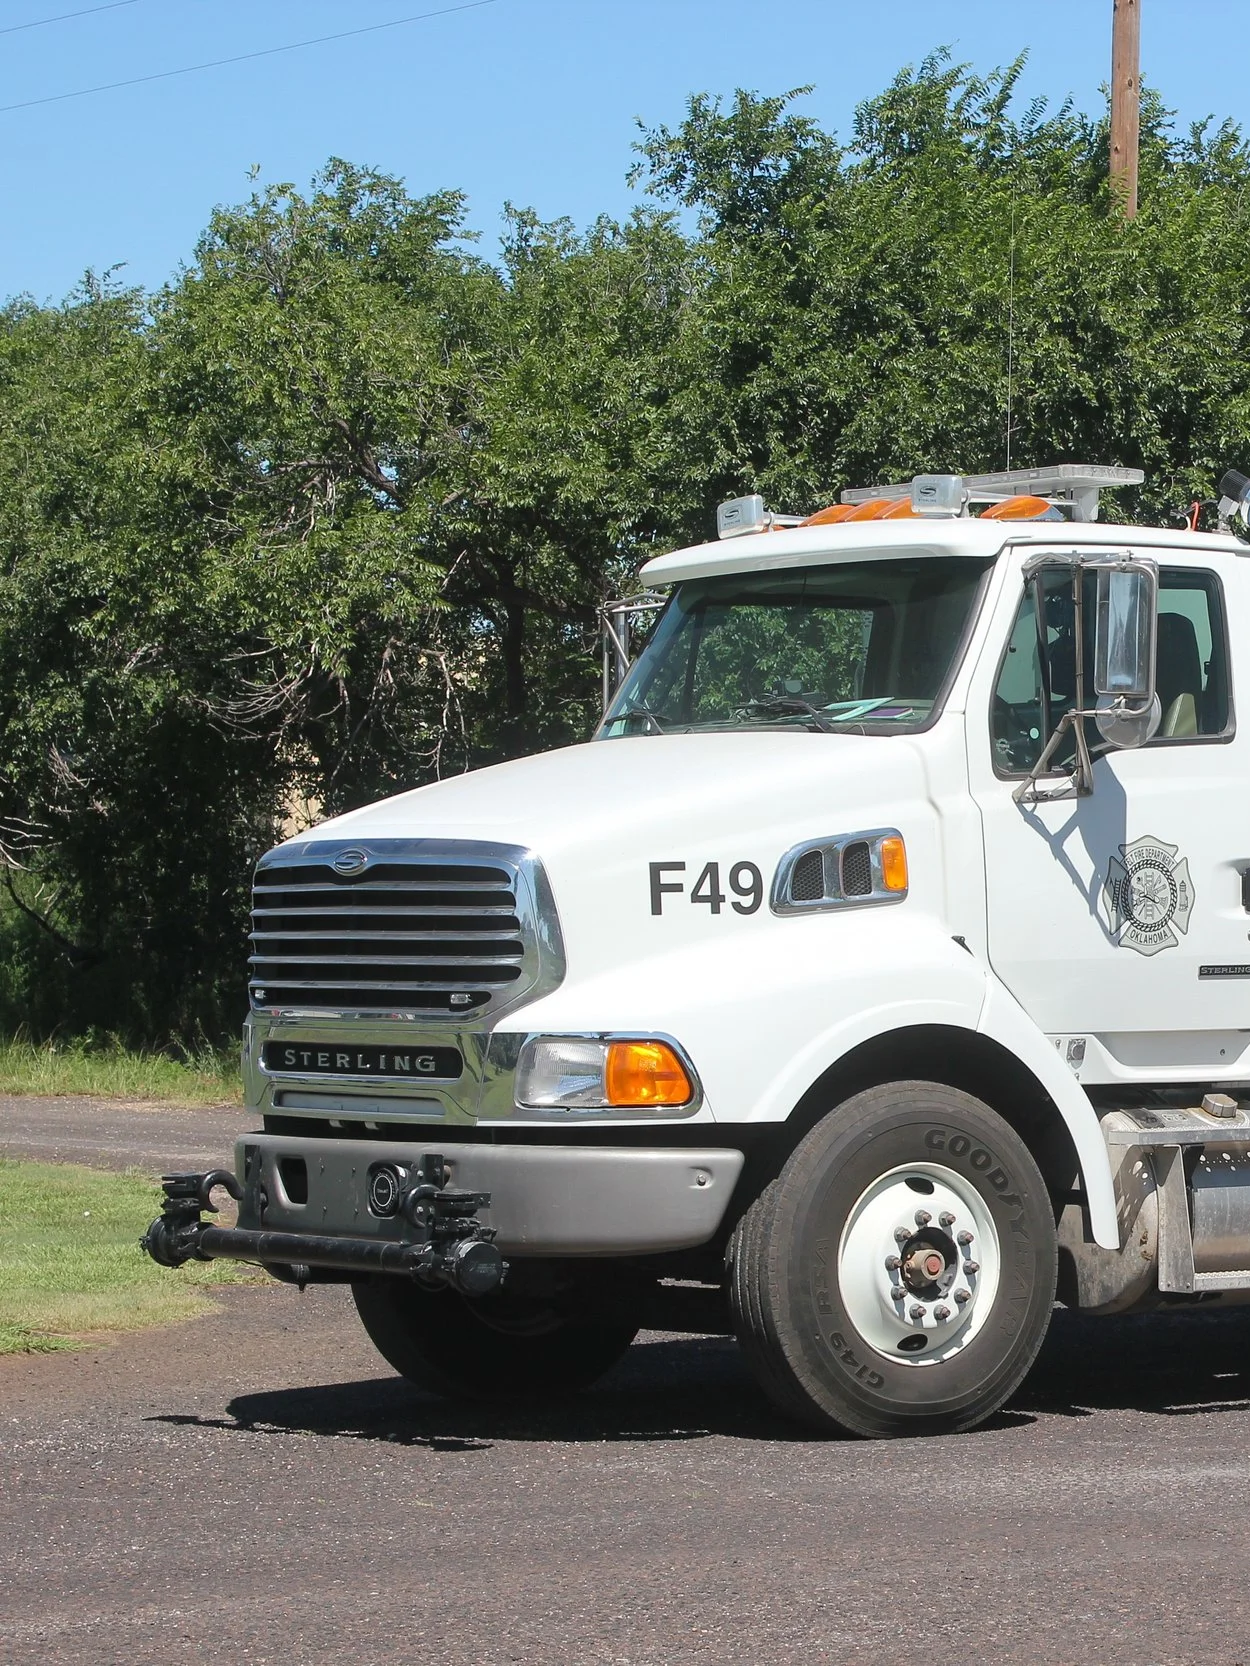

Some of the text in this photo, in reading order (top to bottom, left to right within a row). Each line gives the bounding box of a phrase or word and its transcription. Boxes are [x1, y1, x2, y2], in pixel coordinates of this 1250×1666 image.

[1134, 849, 1145, 861] FIRE
[1145, 848, 1175, 868] DEPARTMENT
[649, 861, 763, 915] F49
[1130, 929, 1168, 943] OKLAHOMA
[284, 1049, 436, 1072] STERLING
[924, 1128, 1031, 1338] GOODYEAR
[830, 1331, 885, 1390] G149
